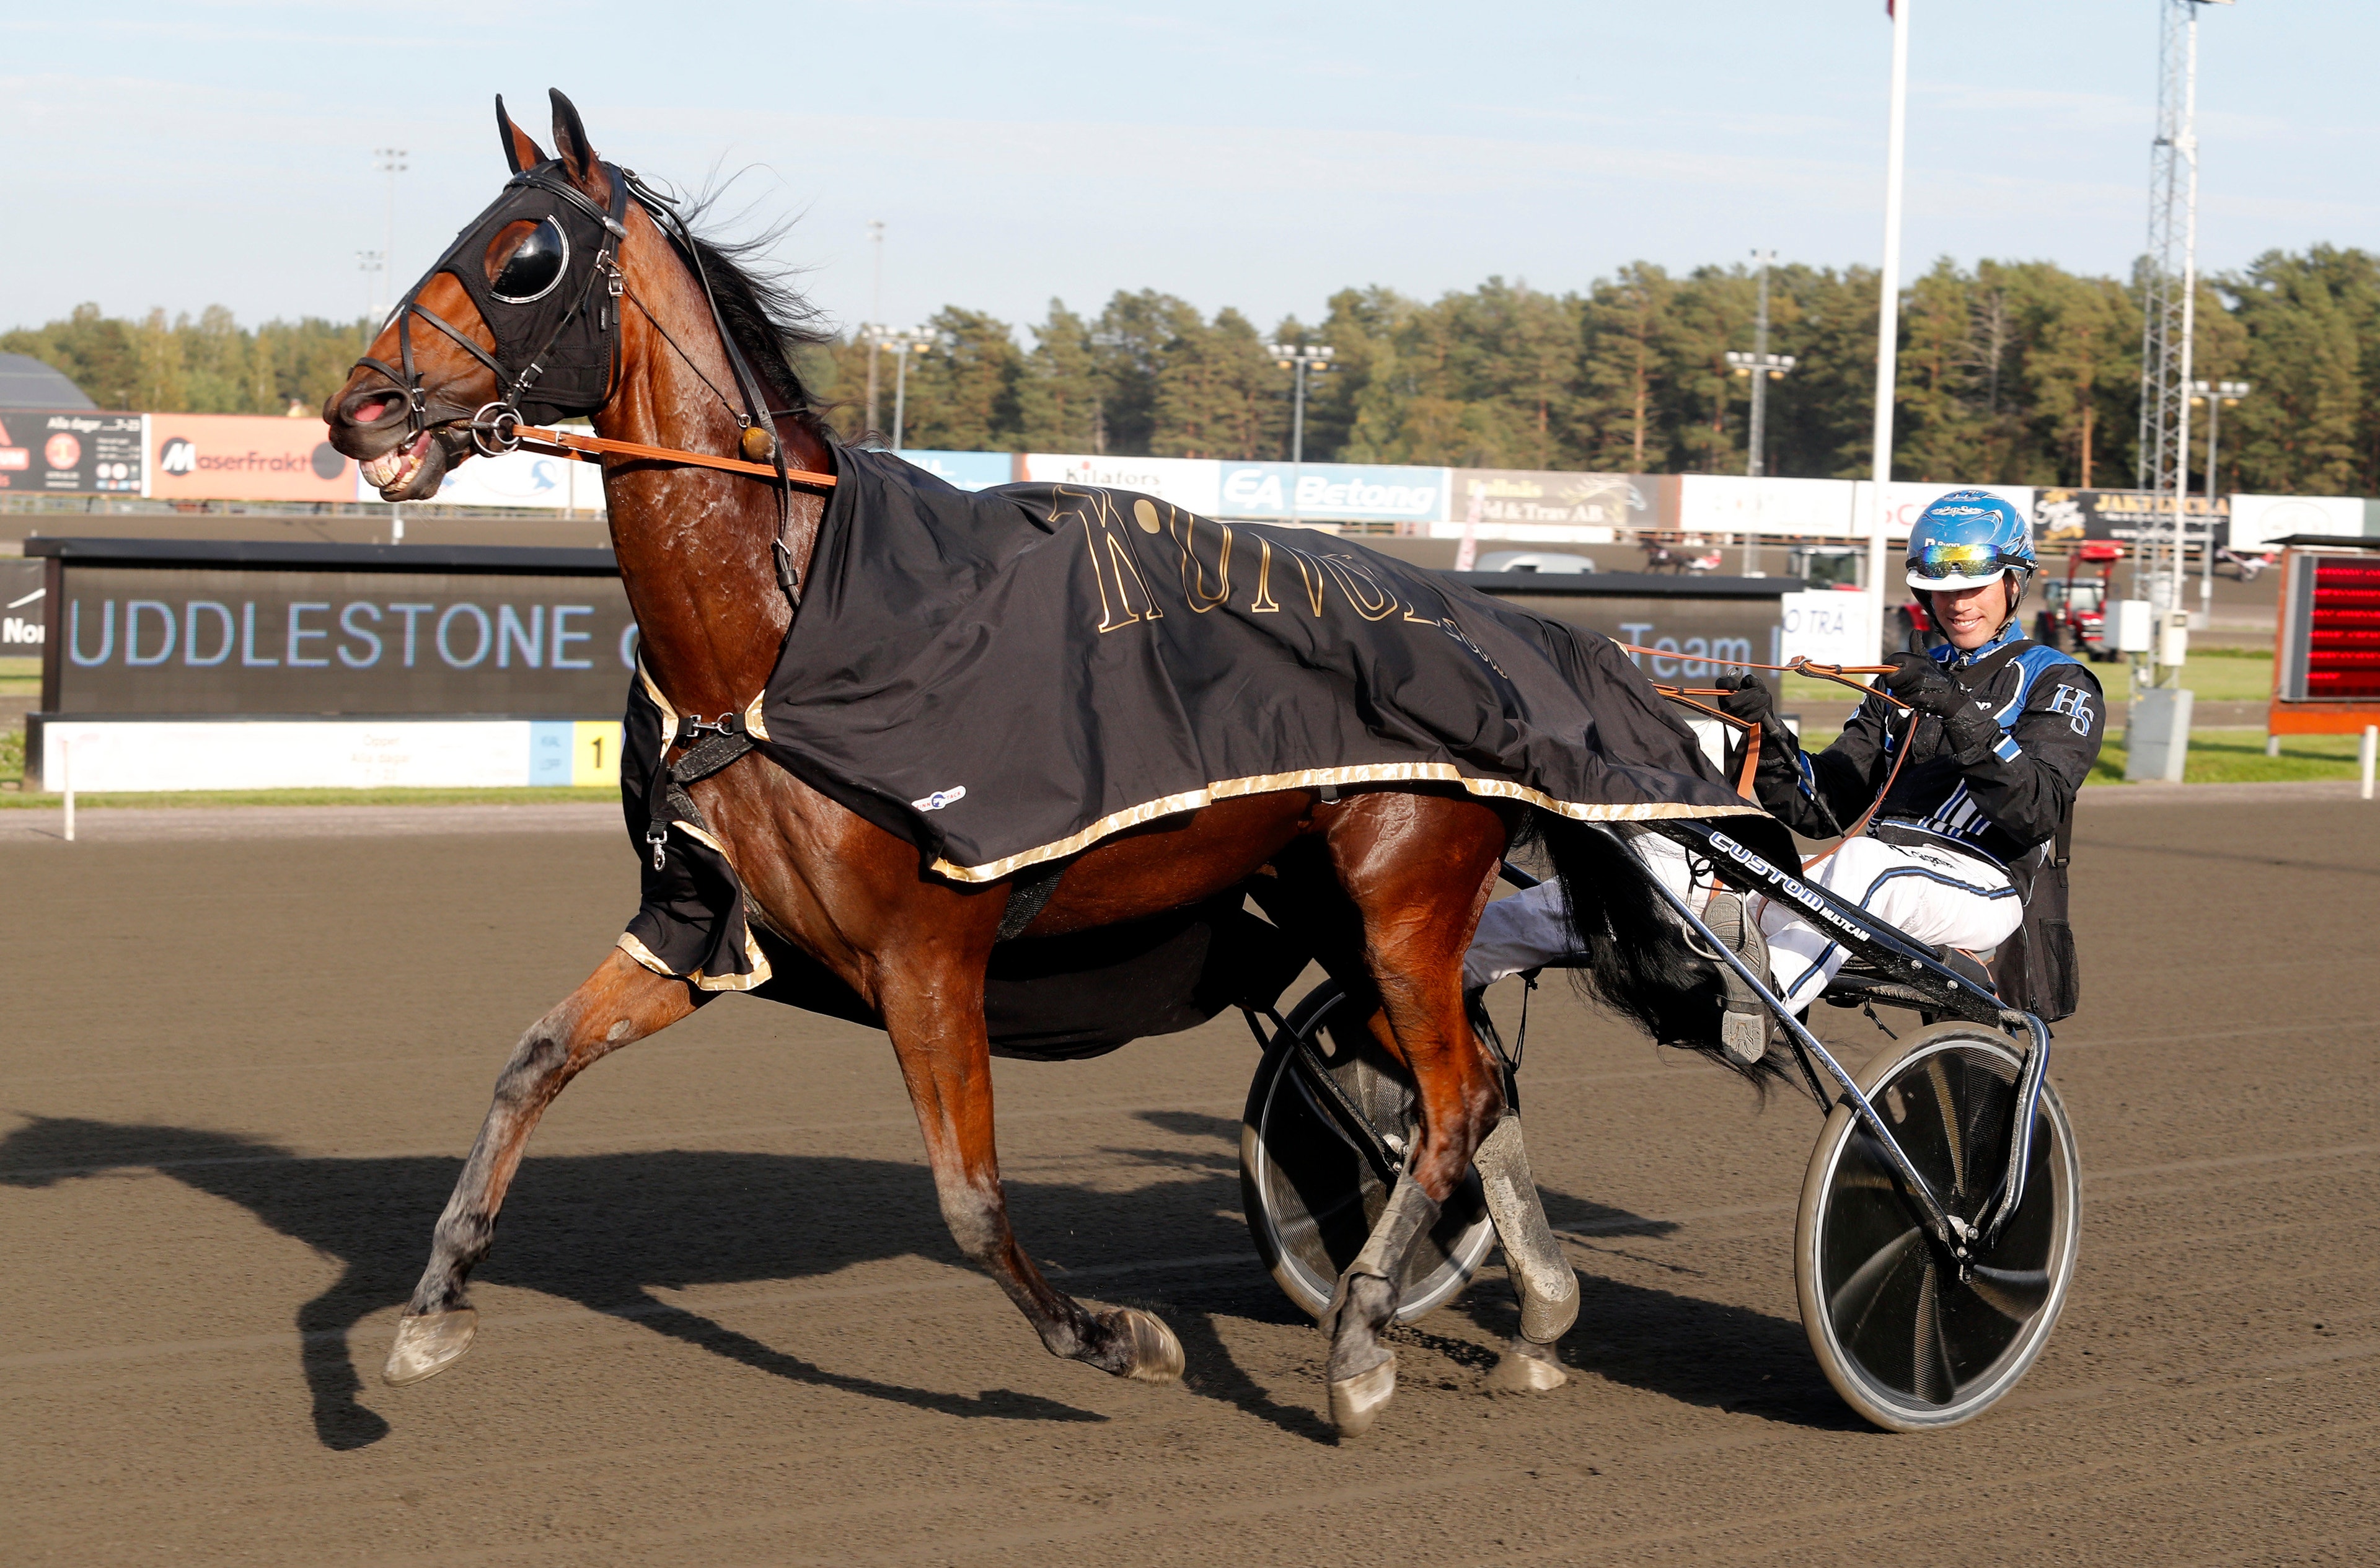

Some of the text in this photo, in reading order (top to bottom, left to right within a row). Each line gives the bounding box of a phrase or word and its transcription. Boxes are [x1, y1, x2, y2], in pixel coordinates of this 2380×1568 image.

[161, 443, 307, 472] MaserFrakt
[1066, 461, 1160, 485] Kilafors
[1223, 469, 1437, 515] EA Betong
[1572, 504, 1605, 522] AB
[69, 599, 594, 669] UDDLESTONE
[1618, 622, 1752, 679] Team
[2045, 683, 2094, 737] HS
[590, 736, 604, 769] 1
[1709, 831, 1825, 912] CUSTOM
[1819, 906, 1871, 942] MULTICAM
